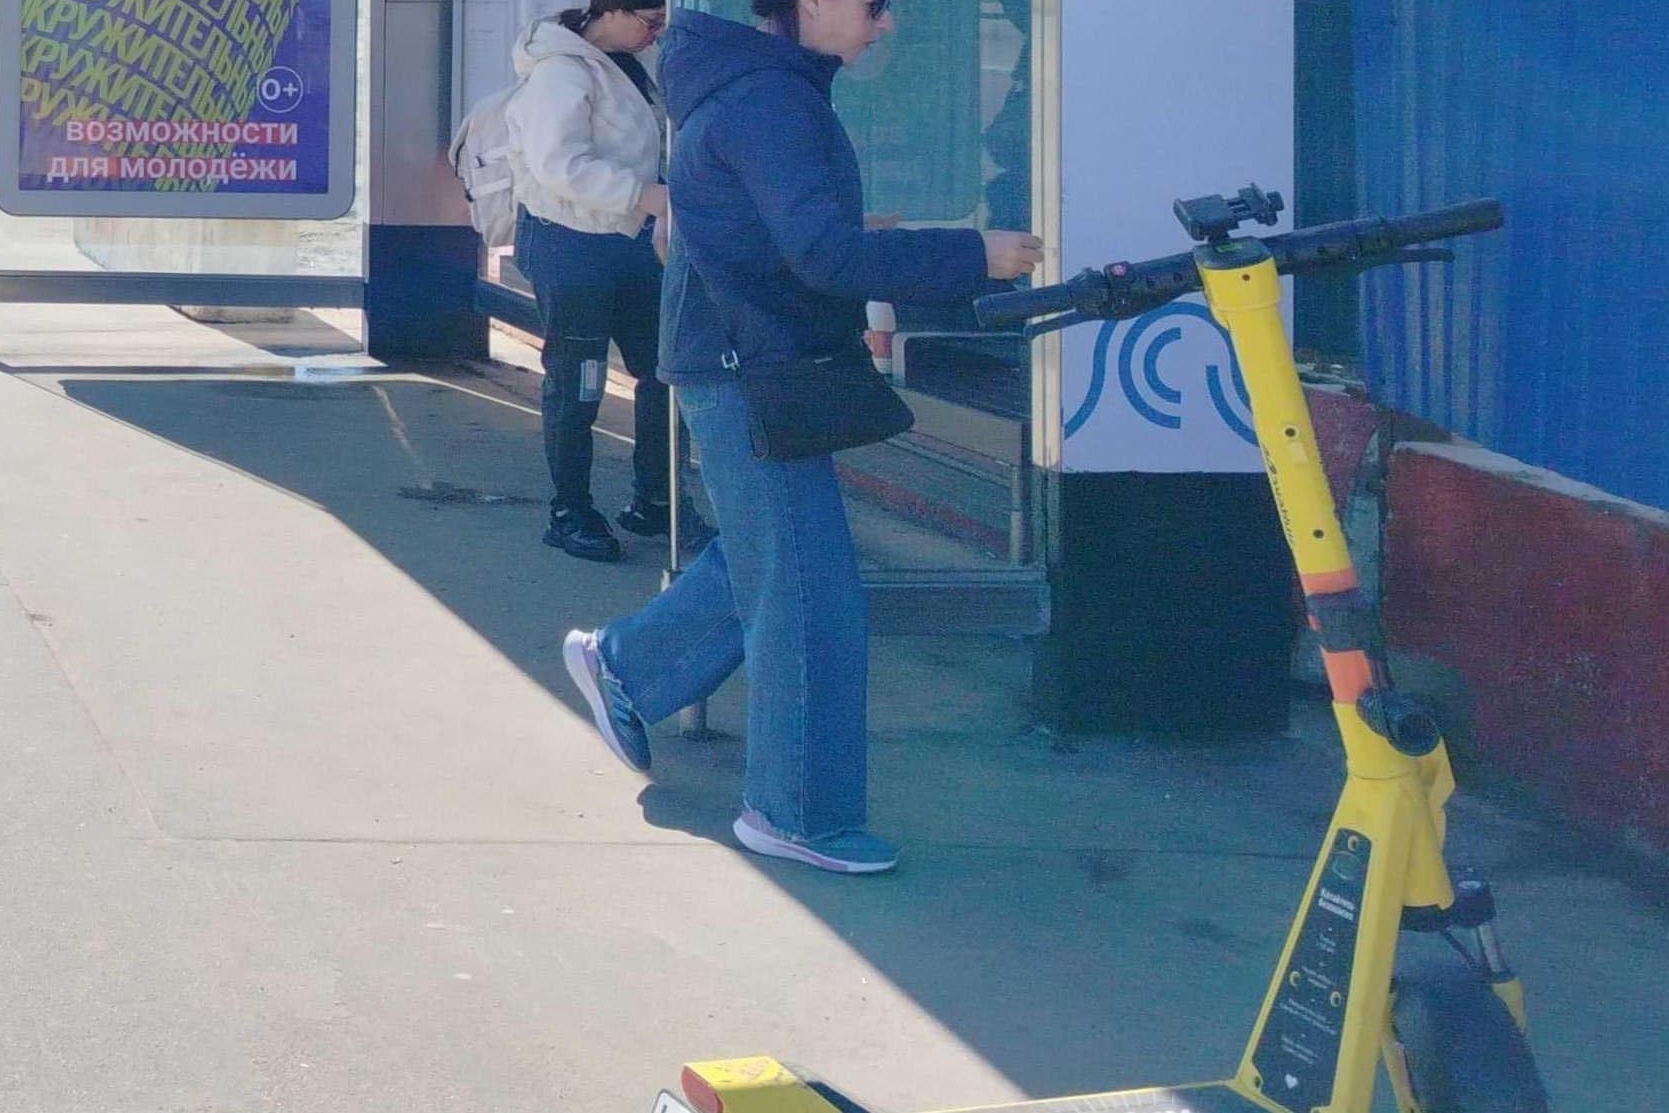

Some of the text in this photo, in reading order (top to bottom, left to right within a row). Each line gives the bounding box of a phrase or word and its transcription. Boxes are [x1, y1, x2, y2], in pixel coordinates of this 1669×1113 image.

[261, 78, 298, 101] 0+
[66, 120, 298, 145] возможности
[47, 152, 297, 184] для молодёжи
